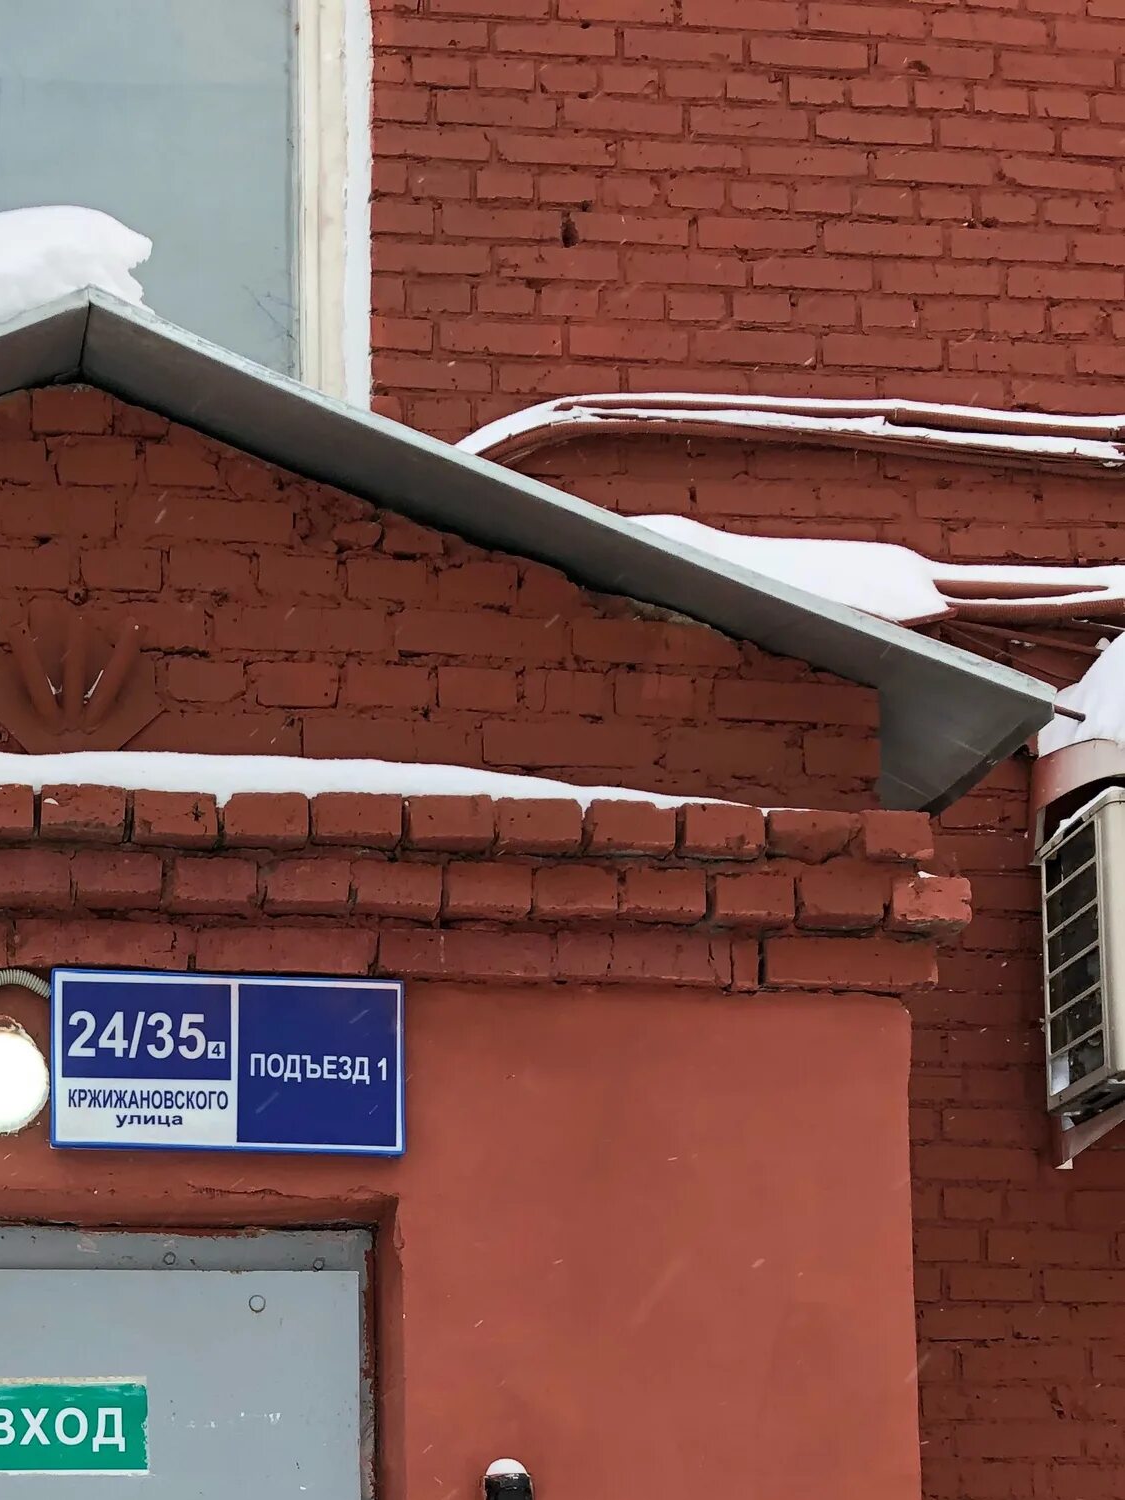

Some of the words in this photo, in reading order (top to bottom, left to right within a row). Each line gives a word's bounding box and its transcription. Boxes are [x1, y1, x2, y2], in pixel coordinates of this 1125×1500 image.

[68, 1011, 206, 1059] 24/35
[250, 1053, 370, 1084] ПОДЪЕЗД
[378, 1058, 388, 1080] 1
[68, 1089, 228, 1110] КРЖИЖАНОВСКОГО
[116, 1113, 183, 1128] улица
